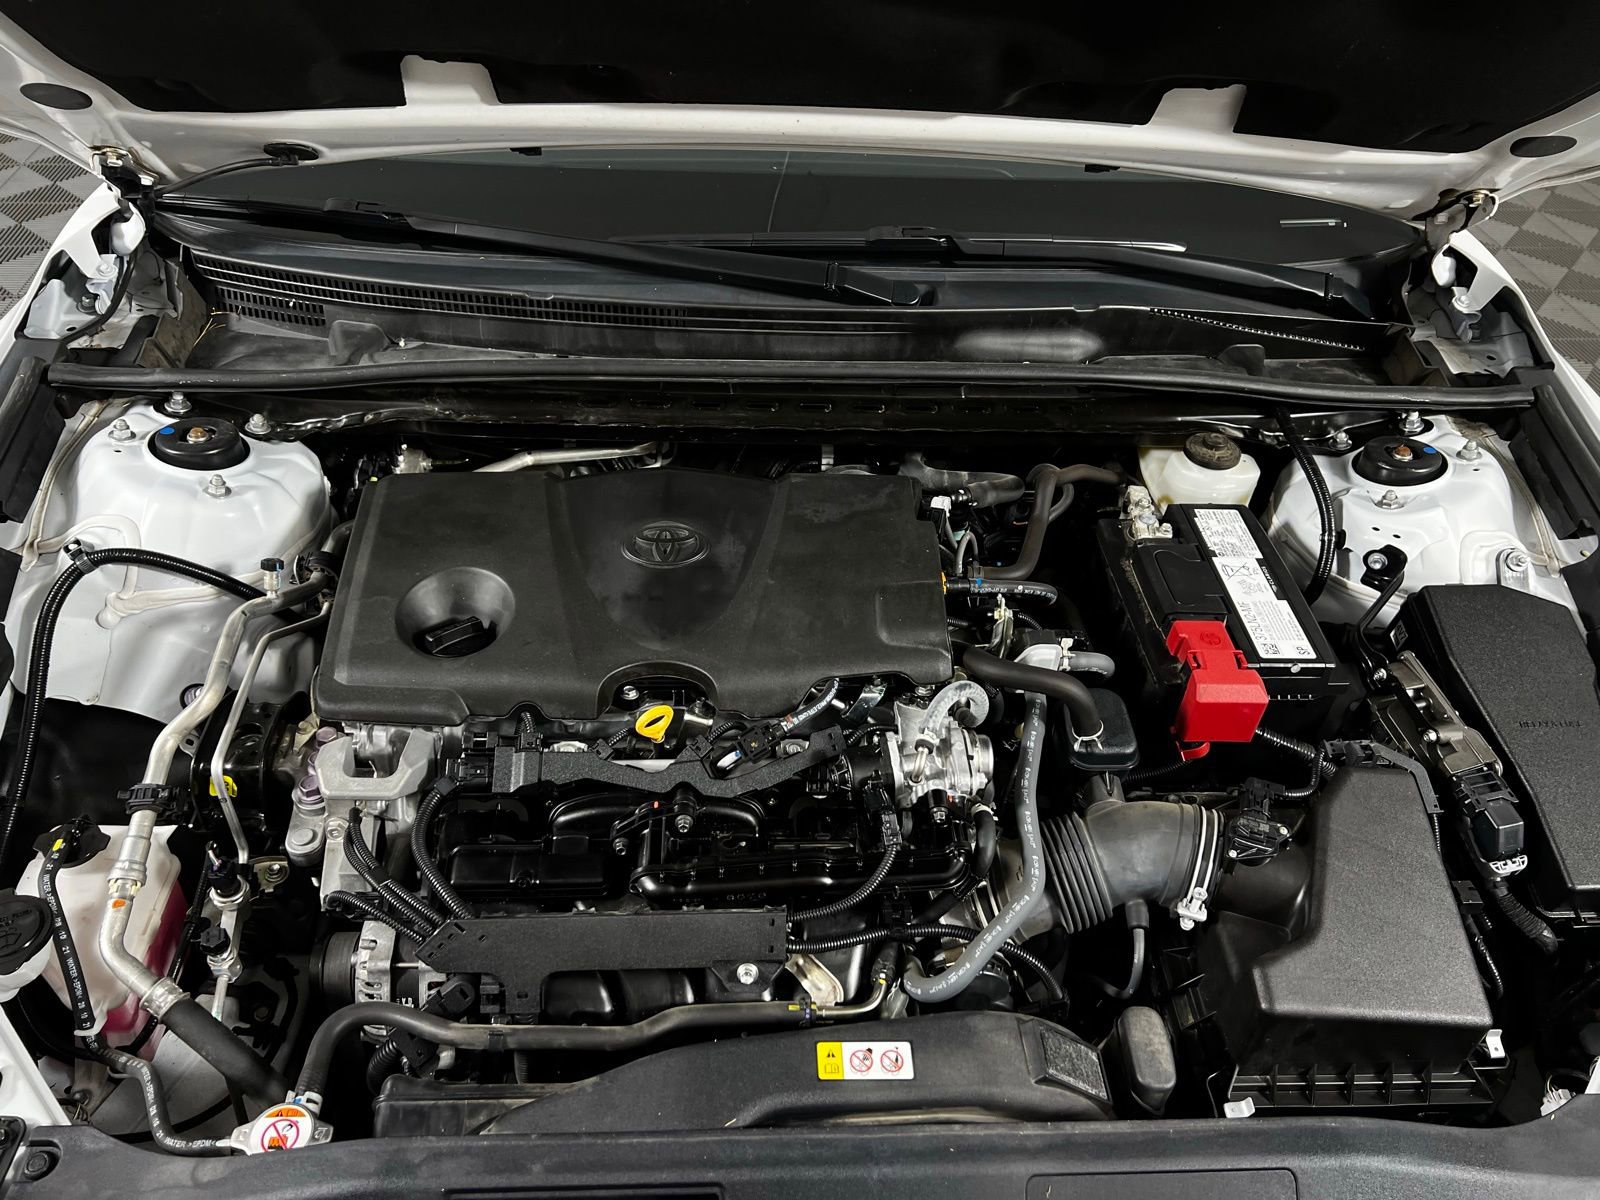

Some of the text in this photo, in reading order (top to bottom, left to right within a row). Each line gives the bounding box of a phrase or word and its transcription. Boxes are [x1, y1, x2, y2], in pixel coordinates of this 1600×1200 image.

[1260, 565, 1275, 586] CLARIOS
[1296, 646, 1311, 656] SP
[43, 873, 51, 893] WATER
[62, 945, 70, 955] 21
[66, 957, 78, 979] WATER
[155, 1129, 164, 1139] 21
[163, 1136, 188, 1149] WATER
